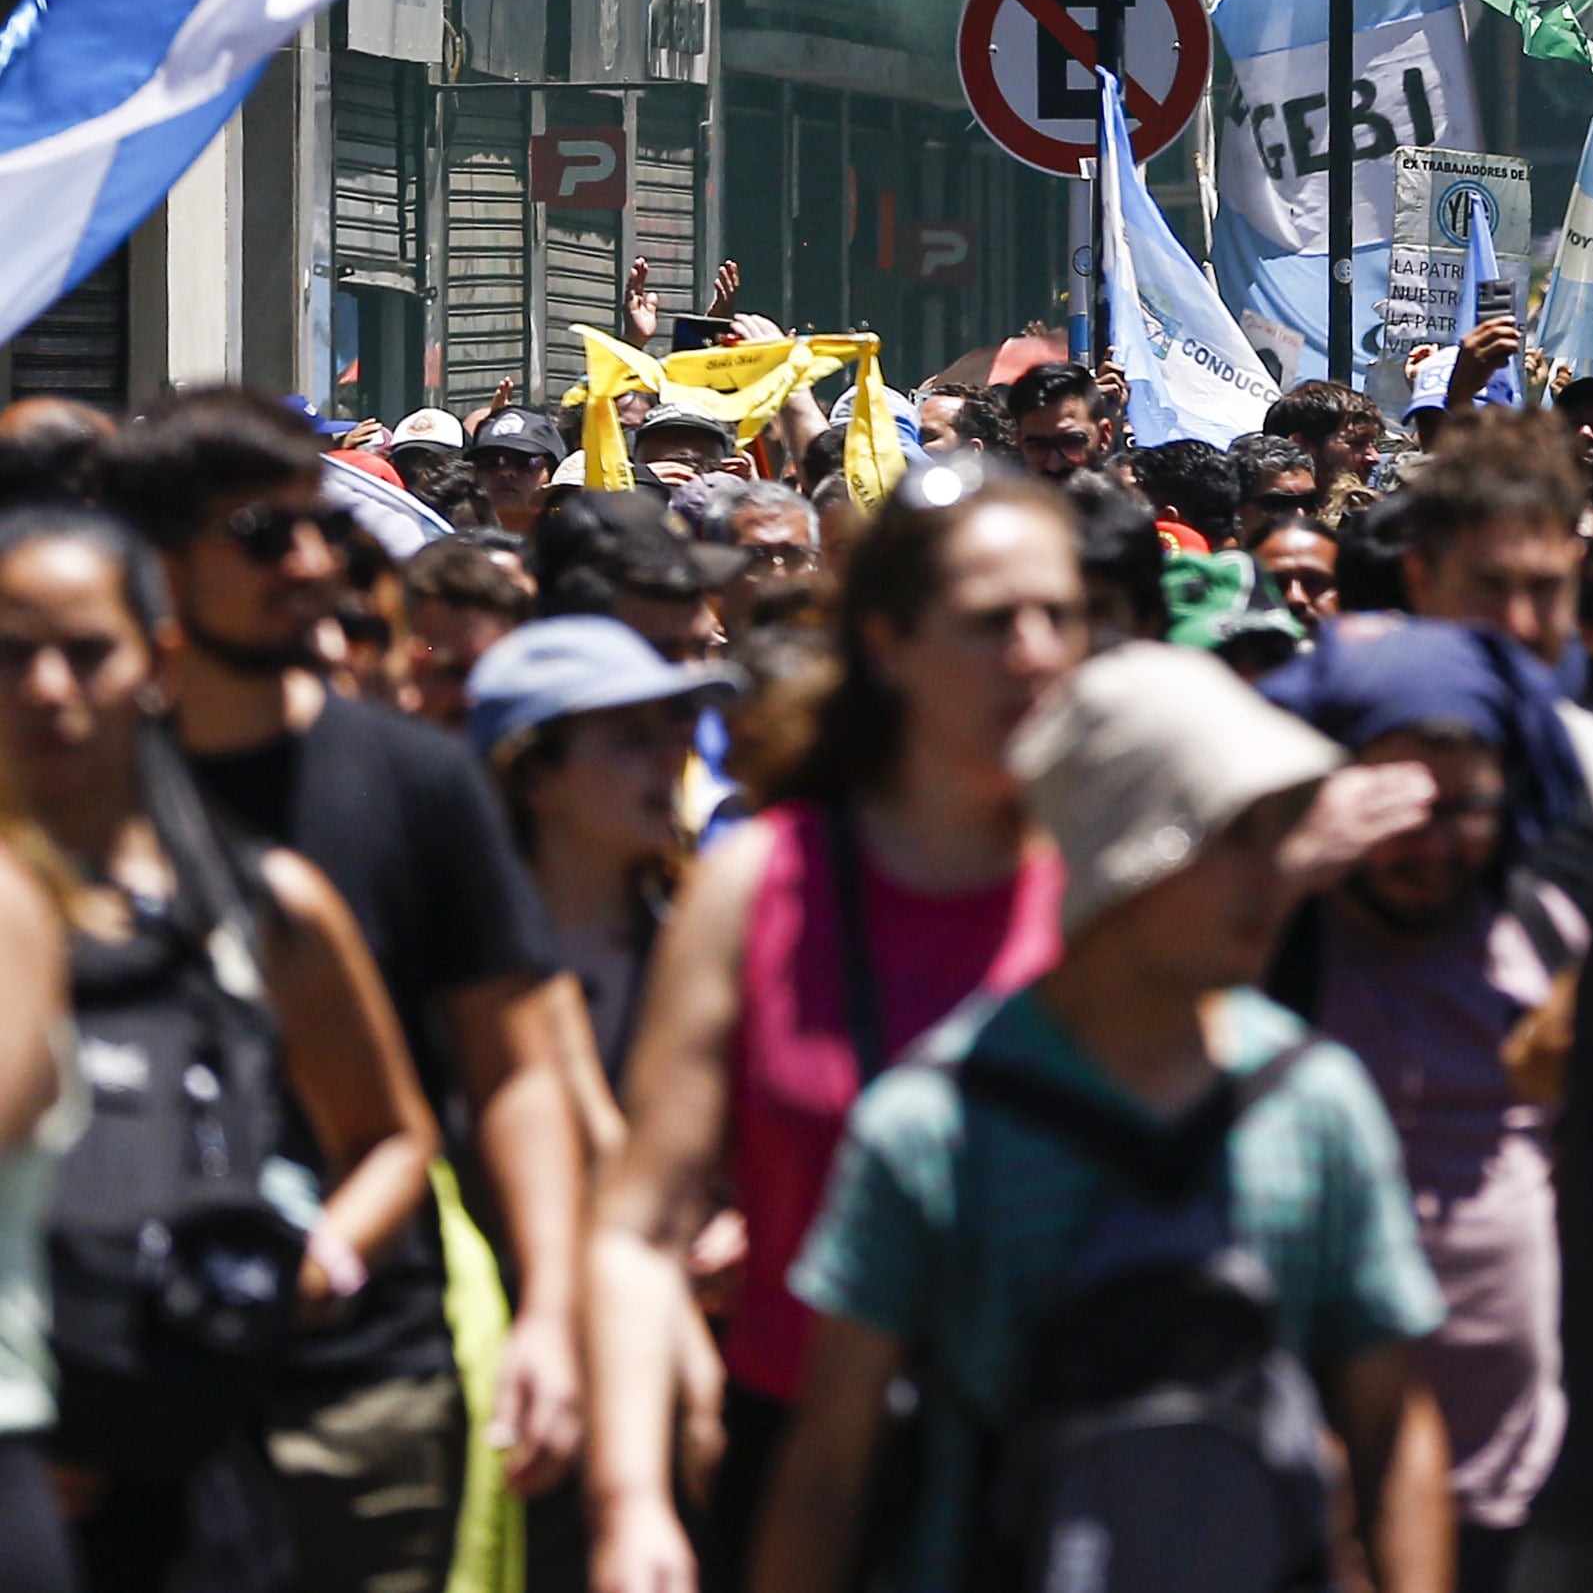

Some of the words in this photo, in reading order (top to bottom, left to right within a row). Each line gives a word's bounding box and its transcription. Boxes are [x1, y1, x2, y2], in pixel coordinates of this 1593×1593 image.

[1402, 158, 1419, 170] EX
[1421, 159, 1508, 179] TRABAJADORES
[1510, 168, 1525, 181] DE
[1393, 259, 1414, 275] LA
[1419, 260, 1464, 280] PATRI
[1391, 286, 1459, 306] NUESTR
